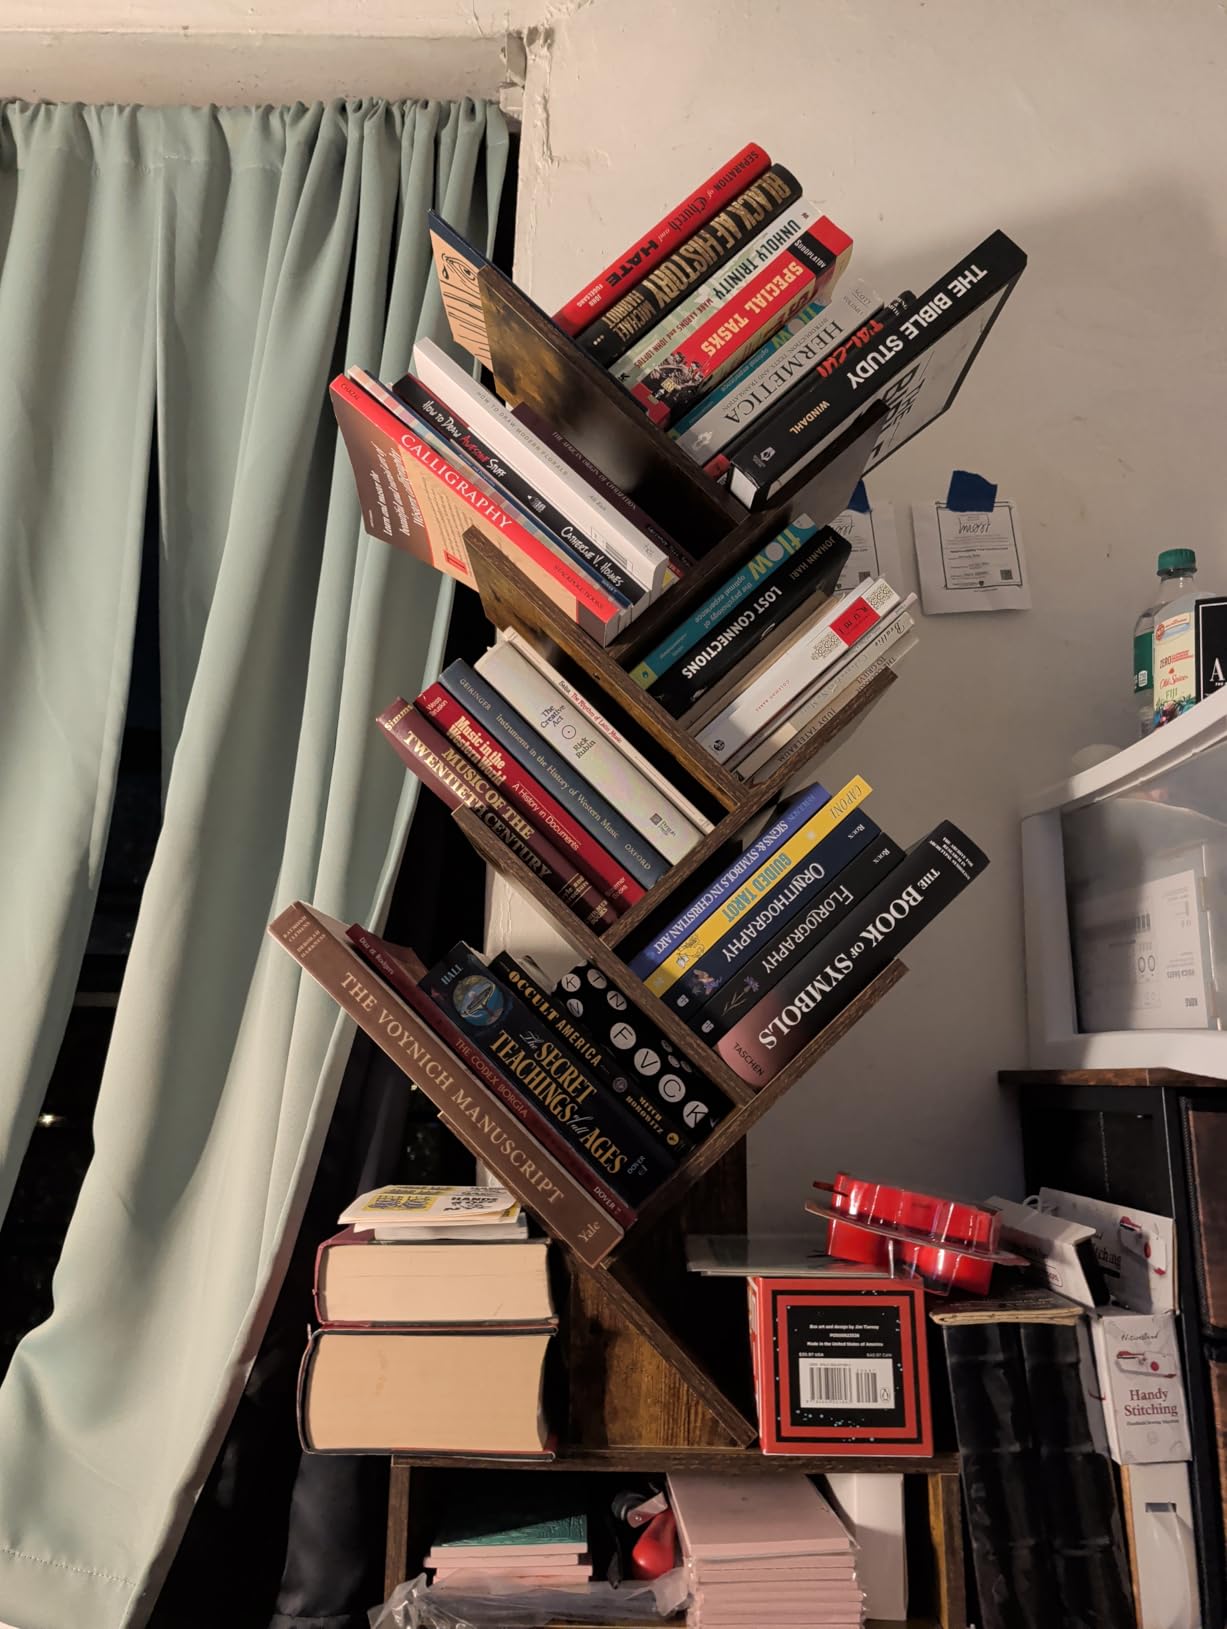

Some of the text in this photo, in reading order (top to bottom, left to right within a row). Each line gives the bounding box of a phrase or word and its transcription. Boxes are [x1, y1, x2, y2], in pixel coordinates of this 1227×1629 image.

[712, 149, 759, 192] SEPARATION
[705, 187, 715, 198] of
[667, 193, 711, 234] Church
[640, 168, 794, 308] BLACK AF HISTORY
[753, 218, 801, 263] UNHOLY
[605, 239, 658, 287] HATE
[711, 255, 758, 300] TRINITY
[948, 259, 988, 297] THE
[576, 282, 603, 307] FUGELSANG
[587, 294, 601, 307] JOHN
[601, 287, 644, 329] HARRIOT
[696, 295, 713, 313] MARK
[699, 260, 804, 358] SPECIAL TASKS
[611, 299, 656, 342] MICHAEL
[675, 309, 698, 332] AARONS
[899, 290, 952, 340] BIBLE
[633, 348, 654, 369] LOFTUS
[652, 336, 667, 352] JOHN
[843, 331, 905, 389] STUDY
[723, 319, 843, 428] HERMETICA
[788, 398, 830, 436] WINDAHL
[551, 431, 563, 442] THE
[397, 431, 513, 532] CALLIGRAPHY
[377, 500, 389, 517] and
[382, 515, 392, 536] Learn
[804, 535, 836, 566] JOHANN
[723, 574, 747, 597] optimal
[741, 581, 754, 593] the
[787, 562, 807, 580] HARI
[706, 587, 745, 623] psychology
[751, 583, 782, 615] LOST
[679, 607, 757, 680] CONNECTIONS
[871, 619, 907, 652] Beattie
[538, 702, 566, 729] Creative
[541, 704, 556, 717] The
[550, 713, 564, 727] Act
[816, 707, 836, 726] JUDY
[444, 723, 507, 787] Western World
[453, 714, 508, 771] Music in the
[572, 735, 589, 752] Rick
[574, 738, 597, 759] Rubin
[440, 745, 536, 841] MUSIC OF THE
[457, 677, 492, 711] GEIRINGER
[494, 712, 532, 750] Instruments
[527, 746, 538, 757] in
[534, 753, 549, 767] the
[543, 764, 570, 791] History
[566, 784, 579, 798] of
[574, 793, 602, 821] Western
[598, 817, 621, 839] Music
[622, 842, 652, 871] OXFORD
[400, 729, 553, 882] TWENTIETH CENTURY
[511, 781, 581, 852] A History in Documents
[651, 818, 789, 954] SIGNS & SYMBOLS IN CHRISTIAN ART
[720, 850, 793, 923] GUIDED TAROT
[439, 961, 464, 986] HALL
[755, 866, 941, 1051] THE BOOK OF SYMBOLS
[505, 968, 604, 1067] OCCULT AMERICA
[518, 1027, 598, 1107] The SECRET
[731, 1041, 764, 1077] TASCHEN
[336, 970, 380, 1013] THE
[372, 1007, 456, 1091] VOYNICH
[450, 1087, 566, 1207] MANUSCRIPT
[486, 1029, 581, 1124] TEACHINGS
[579, 1124, 628, 1175] AGES
[453, 1037, 616, 1210] THE CODEX BORGIA DOVER
[624, 1094, 664, 1135] HOROWITZ
[637, 1095, 664, 1123] MITCH
[626, 1154, 646, 1174] DOVER
[576, 1218, 602, 1243] Yale
[1124, 1403, 1178, 1417] Stitching
[1129, 1387, 1168, 1402] Handy
